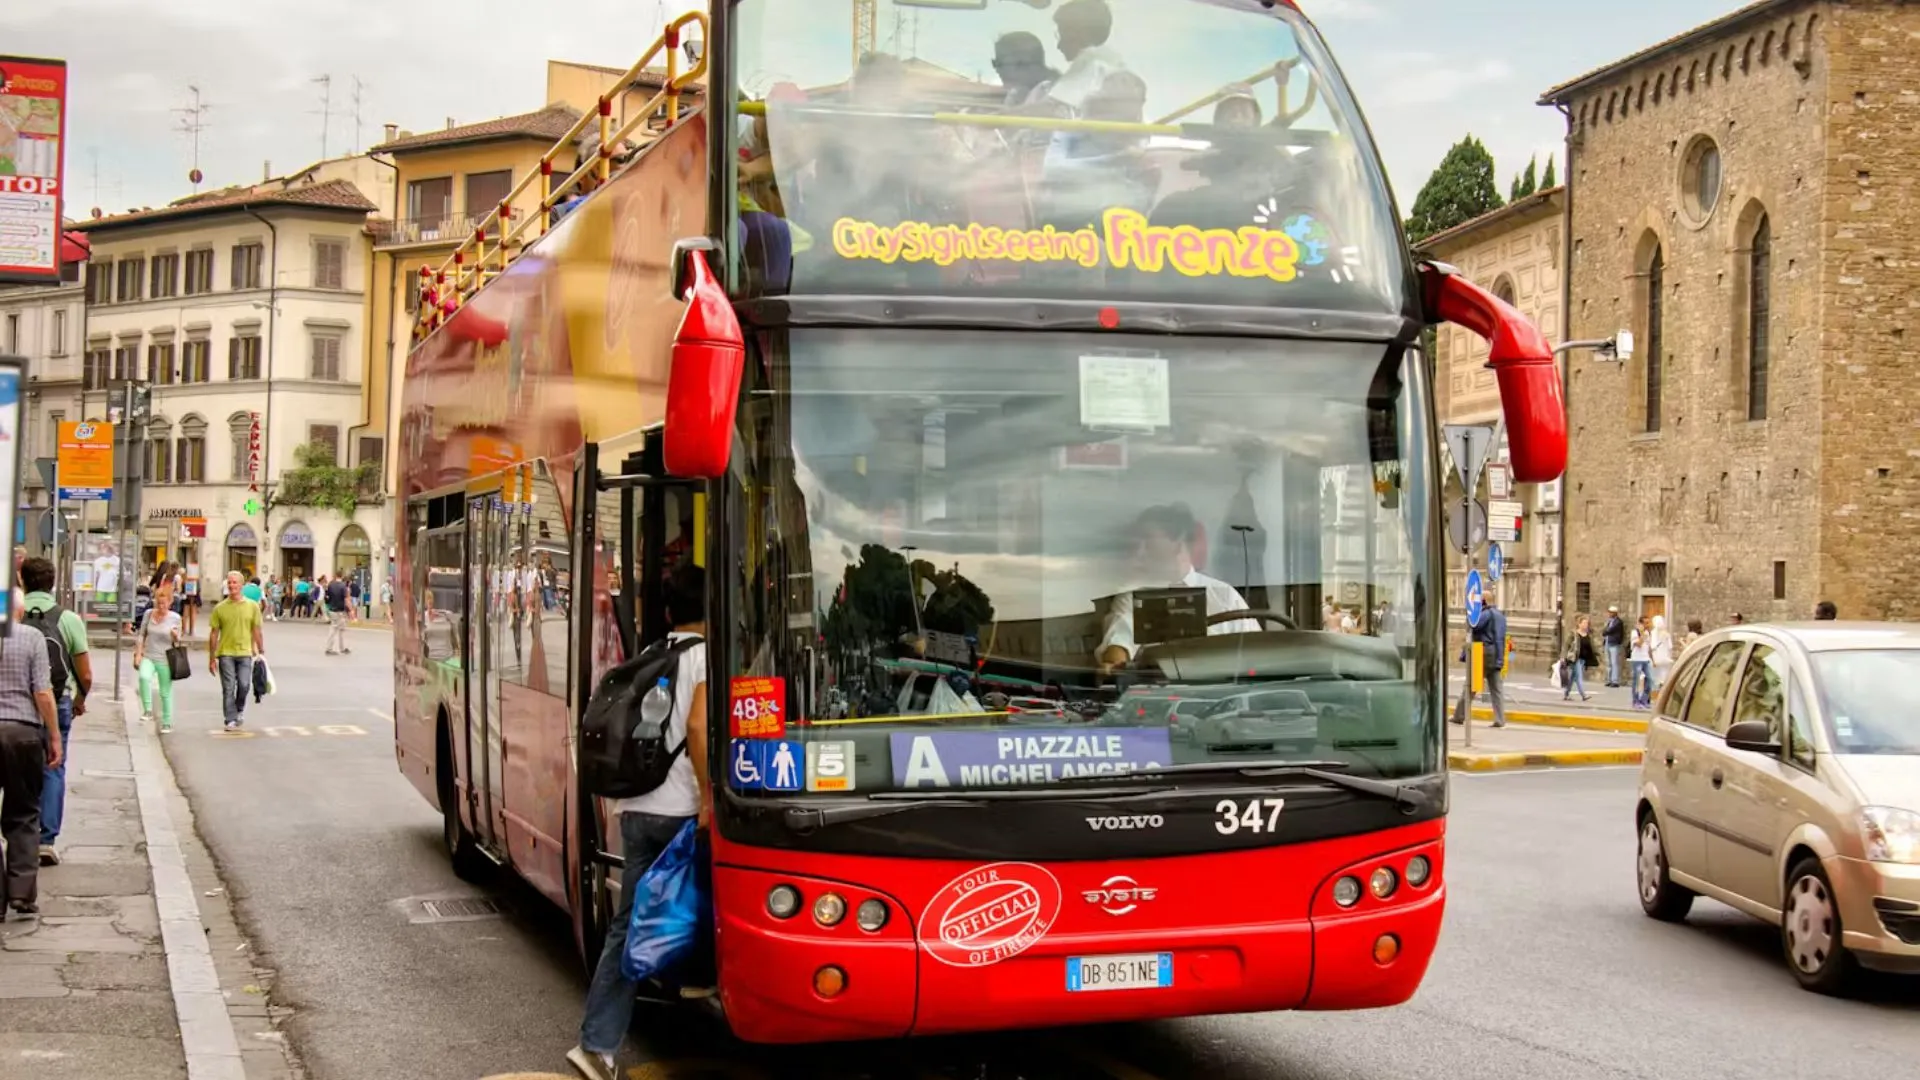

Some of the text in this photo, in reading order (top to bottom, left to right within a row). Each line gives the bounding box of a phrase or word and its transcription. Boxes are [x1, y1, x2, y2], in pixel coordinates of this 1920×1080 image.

[1103, 207, 1299, 282] Firenze
[248, 411, 261, 492] FARMACIA
[733, 697, 758, 720] 48
[817, 752, 845, 775] 5
[903, 735, 951, 788] A
[998, 734, 1123, 760] PIAZZALE
[1085, 814, 1164, 830] VOLVO
[1215, 798, 1285, 834] 347
[953, 870, 999, 896] TOUR
[944, 893, 1036, 941] OFFICIAL
[968, 918, 1047, 964] OF FIRENZE
